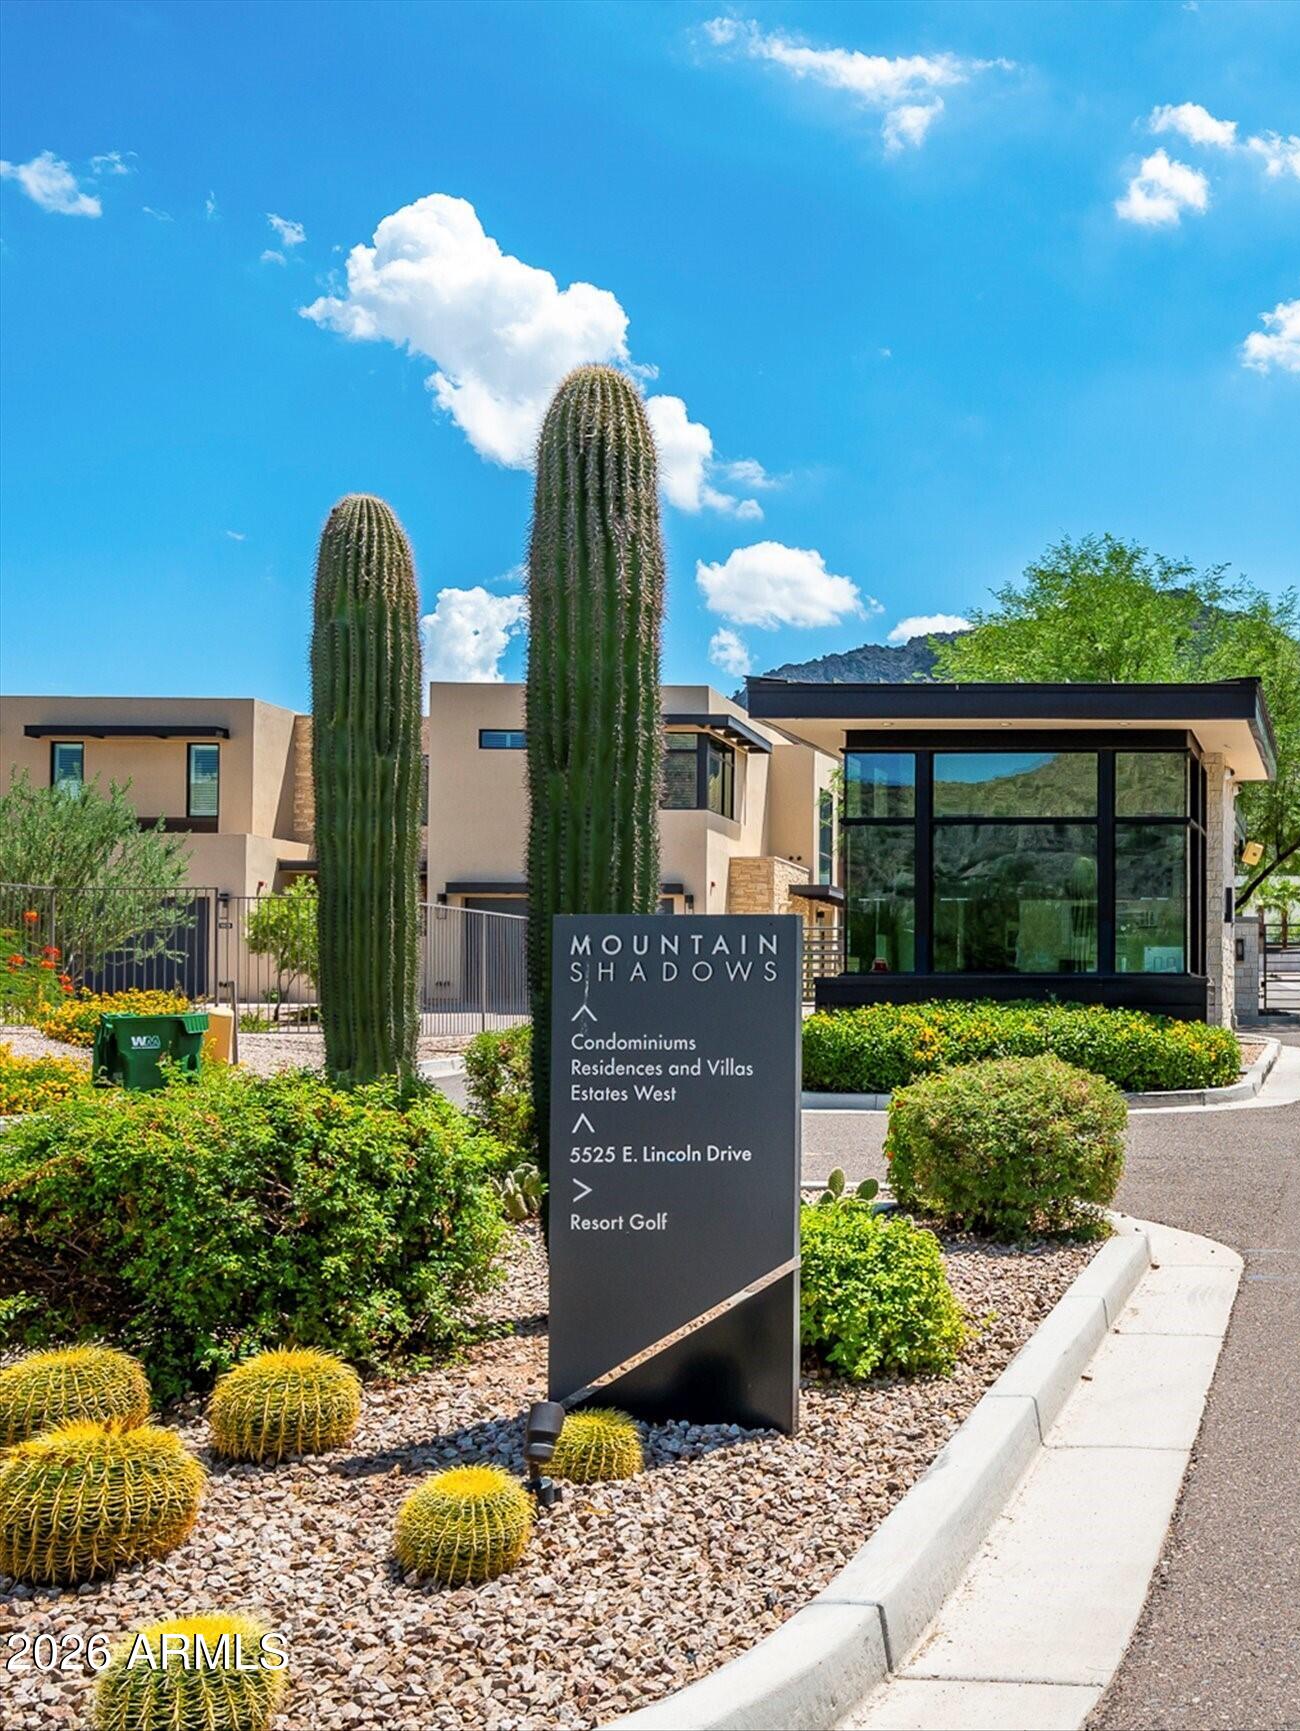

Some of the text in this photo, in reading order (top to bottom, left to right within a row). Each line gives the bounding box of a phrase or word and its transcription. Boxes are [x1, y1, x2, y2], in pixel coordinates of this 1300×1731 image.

[570, 934, 777, 956] MOUNTAIN
[570, 961, 777, 983] SHADOWS
[571, 1032, 697, 1051] Condominiums
[571, 1057, 754, 1077] Residences and Villas
[571, 1084, 677, 1102] Estates West
[569, 1144, 753, 1164] 5525 E. Lincoln Drive
[570, 1212, 668, 1231] Resort Golf
